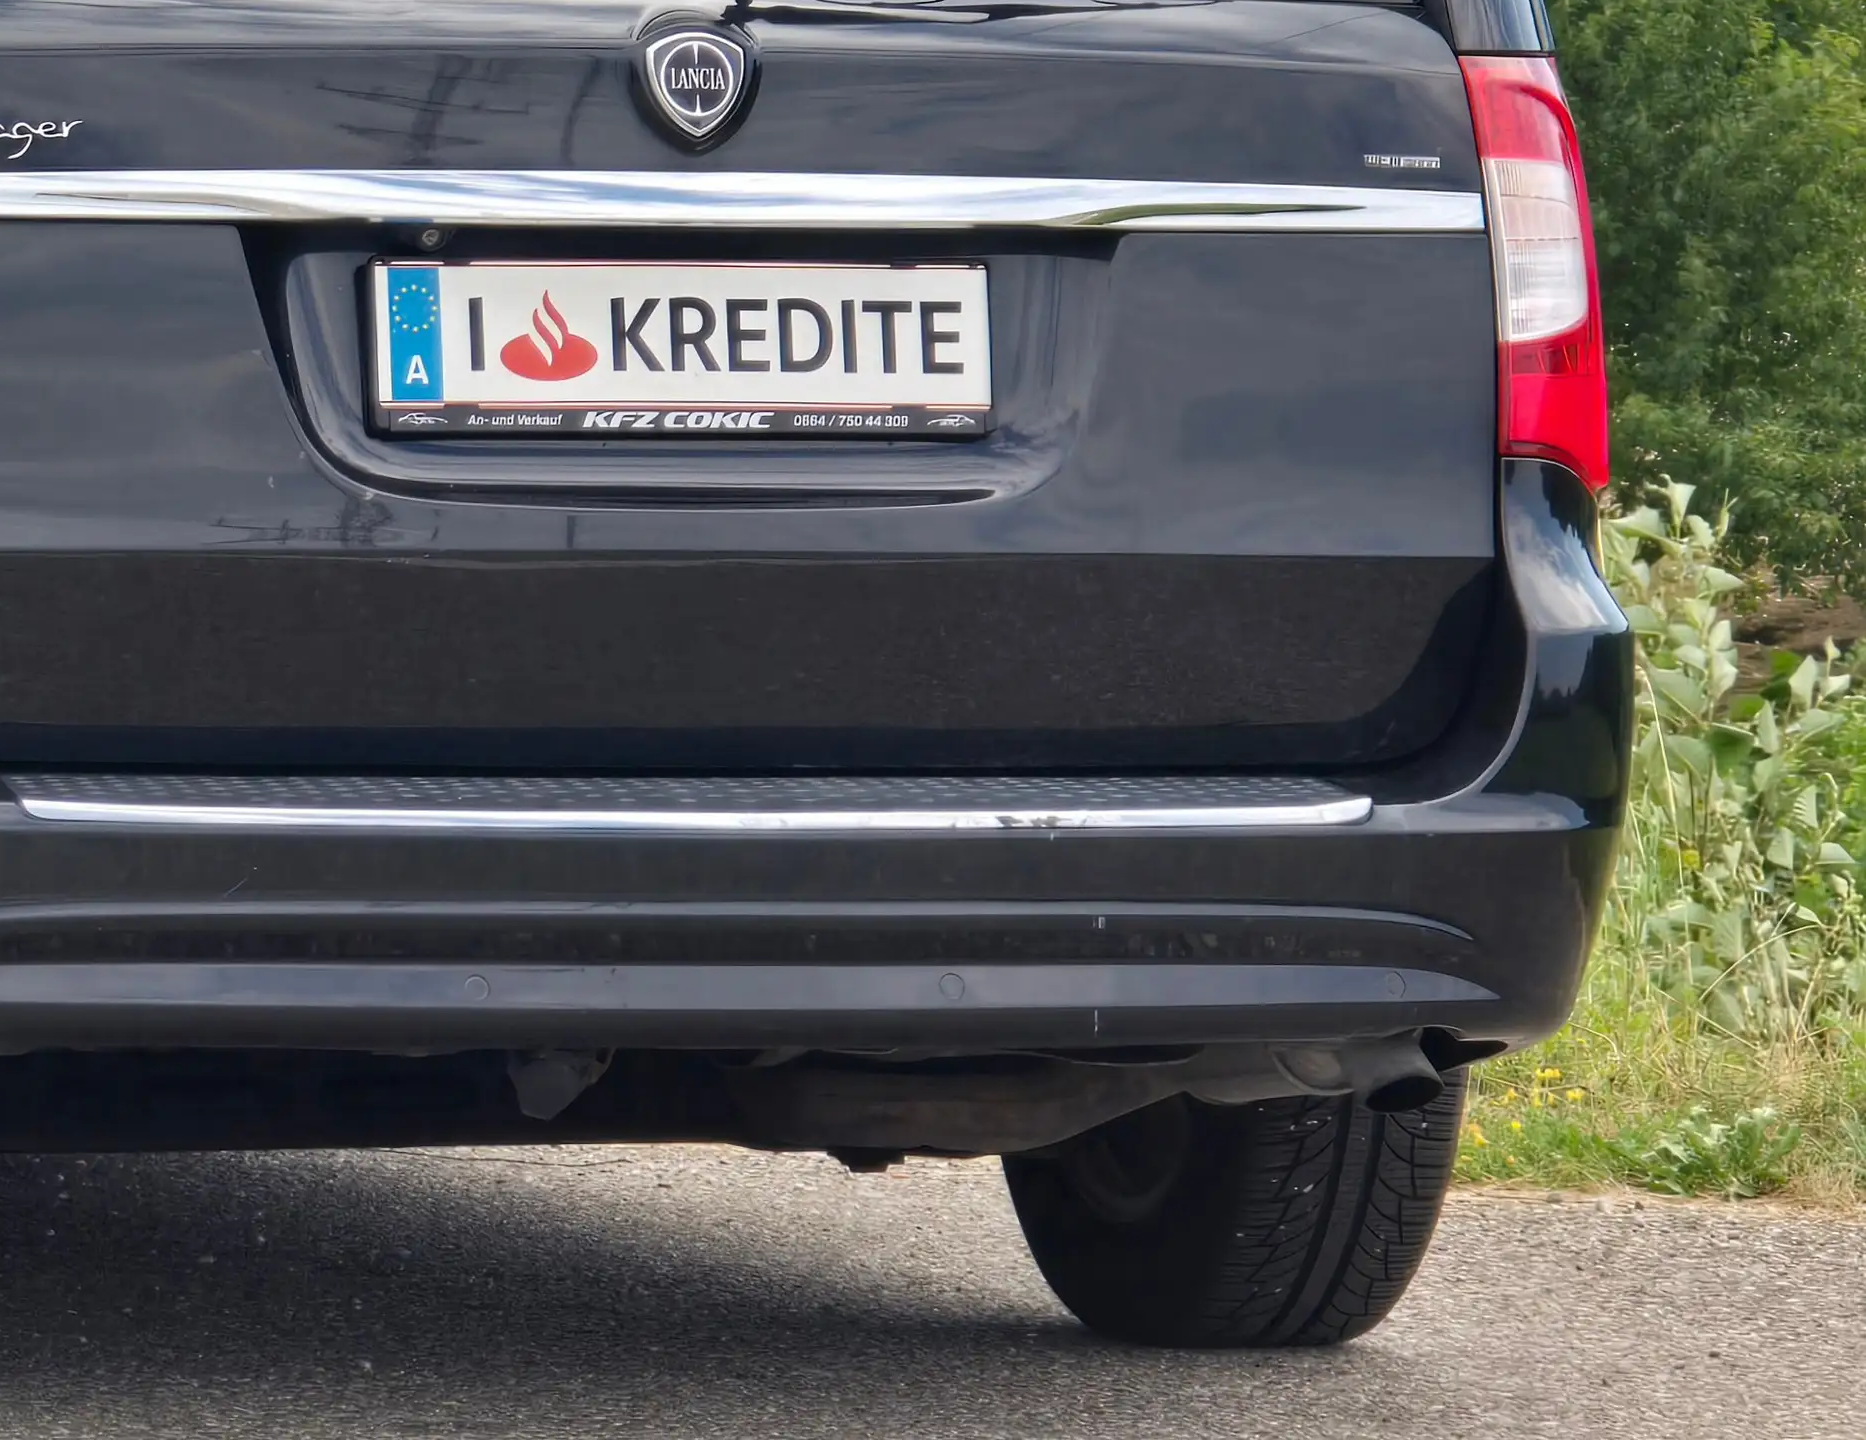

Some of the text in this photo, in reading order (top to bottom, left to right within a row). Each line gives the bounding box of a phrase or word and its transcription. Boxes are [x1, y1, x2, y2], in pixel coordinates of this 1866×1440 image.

[671, 67, 726, 90] LANCIA
[468, 296, 965, 375] I KREDITE
[405, 354, 430, 385] A
[491, 414, 515, 426] und
[582, 411, 660, 428] KFZ
[664, 411, 775, 429] COKIC
[865, 415, 882, 427] 44
